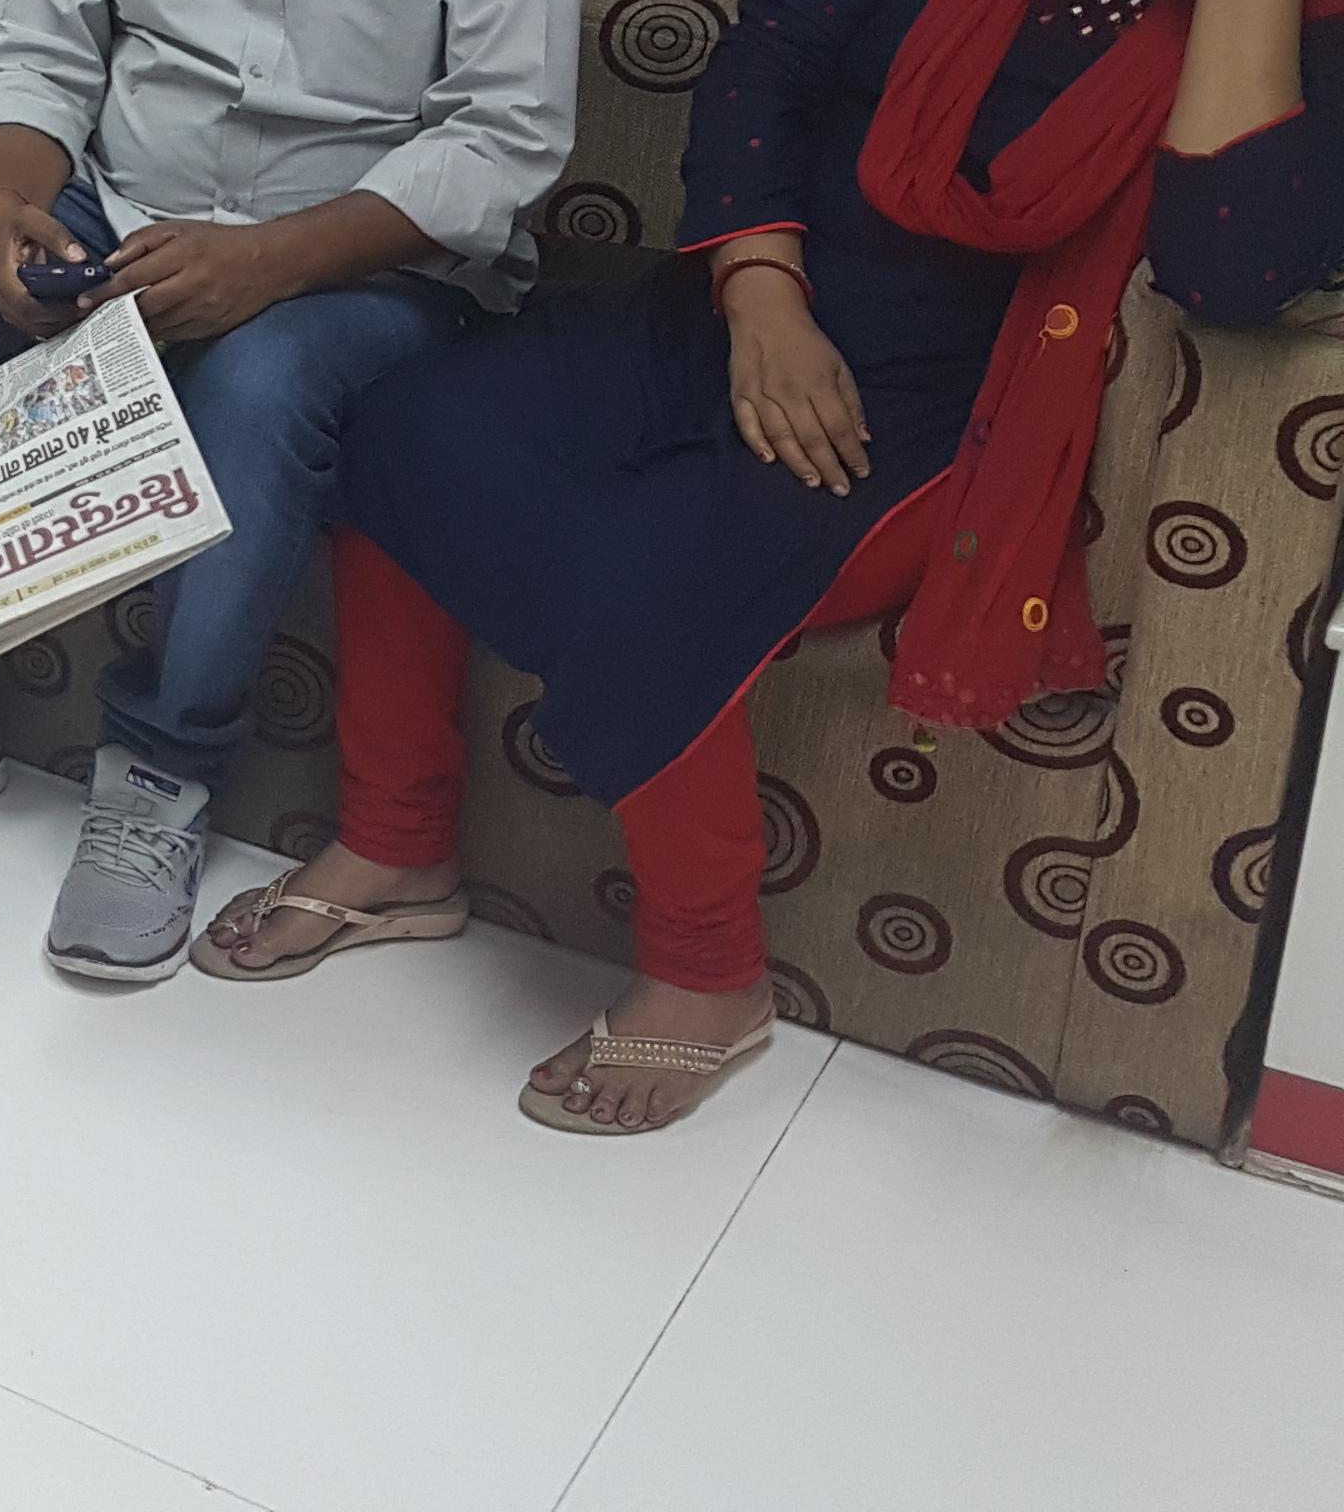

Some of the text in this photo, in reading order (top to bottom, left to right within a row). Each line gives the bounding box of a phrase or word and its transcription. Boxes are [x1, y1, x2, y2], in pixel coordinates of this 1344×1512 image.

[112, 393, 162, 431] असम
[23, 437, 65, 469] लाख
[66, 426, 89, 451] 40
